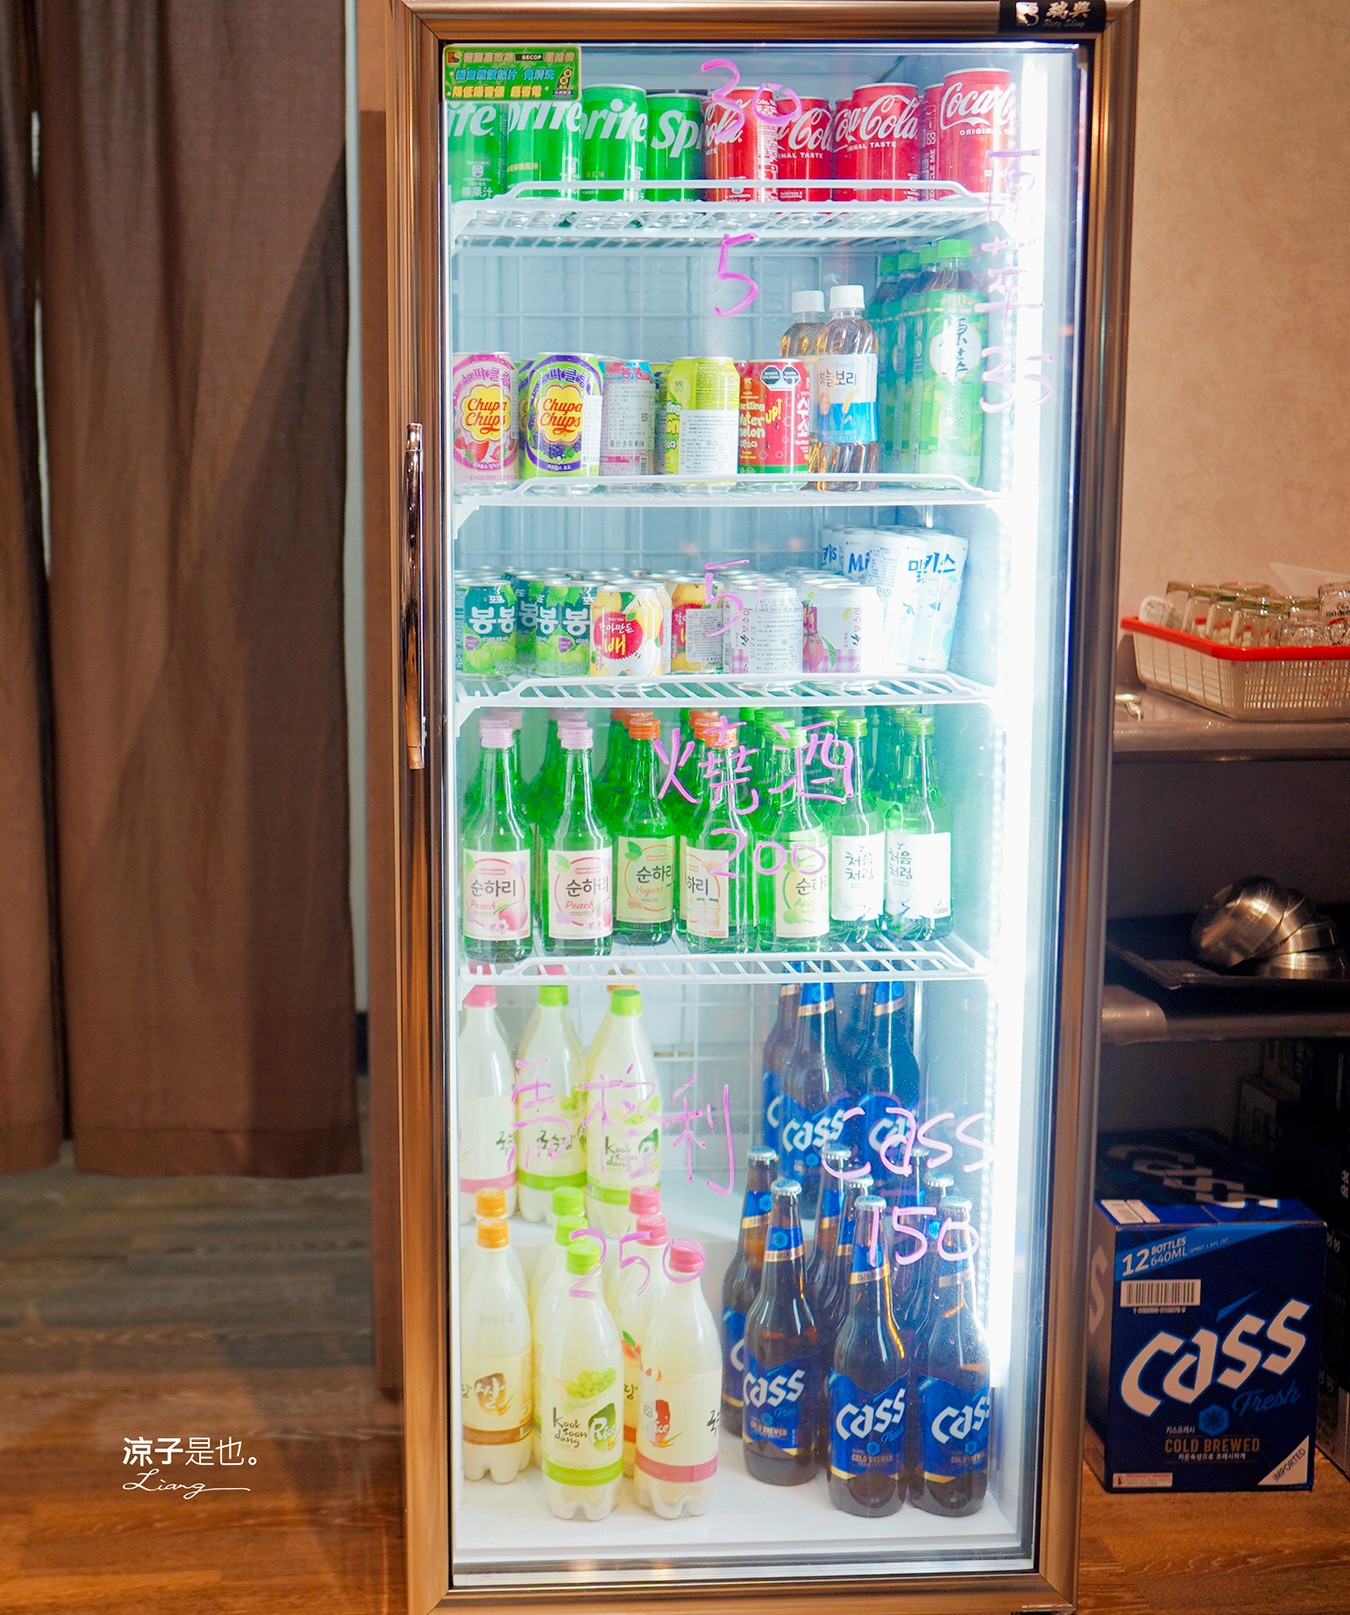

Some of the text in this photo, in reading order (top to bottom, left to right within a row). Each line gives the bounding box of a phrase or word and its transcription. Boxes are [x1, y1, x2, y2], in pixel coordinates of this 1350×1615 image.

[581, 98, 648, 142] rite
[869, 141, 897, 149] TASTE
[714, 233, 760, 318] 5
[467, 398, 508, 416] Chupa
[542, 398, 584, 417] Chupa
[765, 398, 782, 424] UP!
[464, 412, 506, 435] Chups
[540, 411, 581, 436] Chups
[469, 606, 516, 634] 봉봉
[519, 600, 538, 627] 봉
[537, 607, 591, 636] 봉봉
[604, 635, 626, 656] 배
[653, 715, 854, 815] 燒酒
[710, 827, 827, 878] 200
[470, 879, 516, 897] 순하리
[565, 877, 609, 897] 순하리
[635, 886, 664, 898] Yogurt
[469, 900, 496, 910] Peach
[564, 900, 594, 909] Peach
[782, 1109, 845, 1153] Cass
[821, 1105, 997, 1180] Cass
[869, 1205, 980, 1268] 150
[1151, 1236, 1187, 1256] BOTTLES
[568, 1228, 708, 1298] 250
[1122, 1248, 1150, 1277] 12
[1150, 1247, 1187, 1267] 640ML
[1120, 1299, 1312, 1418] Cass
[743, 1369, 806, 1408] Cass
[1231, 1380, 1301, 1418] Fresh
[654, 1420, 669, 1434] ice
[835, 1388, 906, 1441] Cass
[554, 1432, 580, 1448] dang
[590, 1416, 616, 1442] Rice
[1165, 1437, 1261, 1454] COLD BREWED
[1272, 1447, 1307, 1483] IMPORTED
